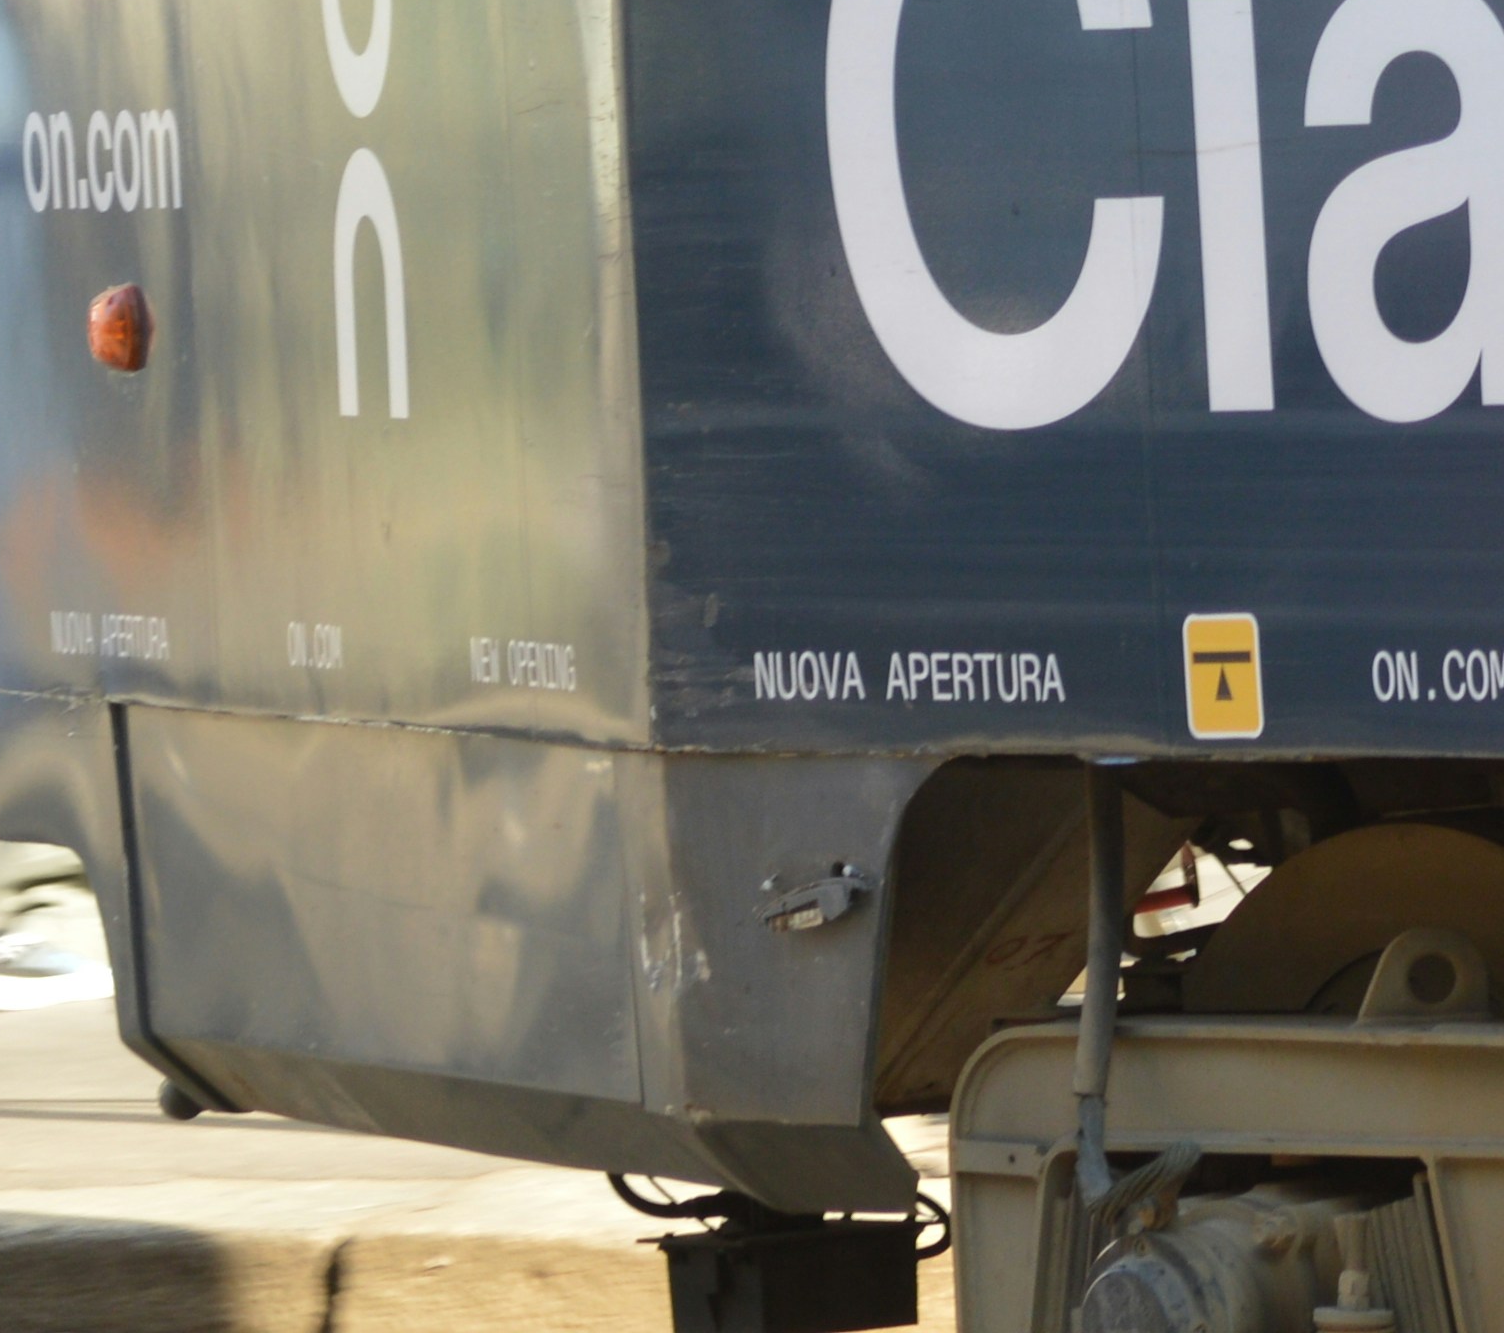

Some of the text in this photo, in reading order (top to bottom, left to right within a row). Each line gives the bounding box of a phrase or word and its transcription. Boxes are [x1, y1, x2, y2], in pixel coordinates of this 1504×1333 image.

[23, 108, 182, 214] on.com
[753, 650, 1066, 703] NUOVA APERTURA
